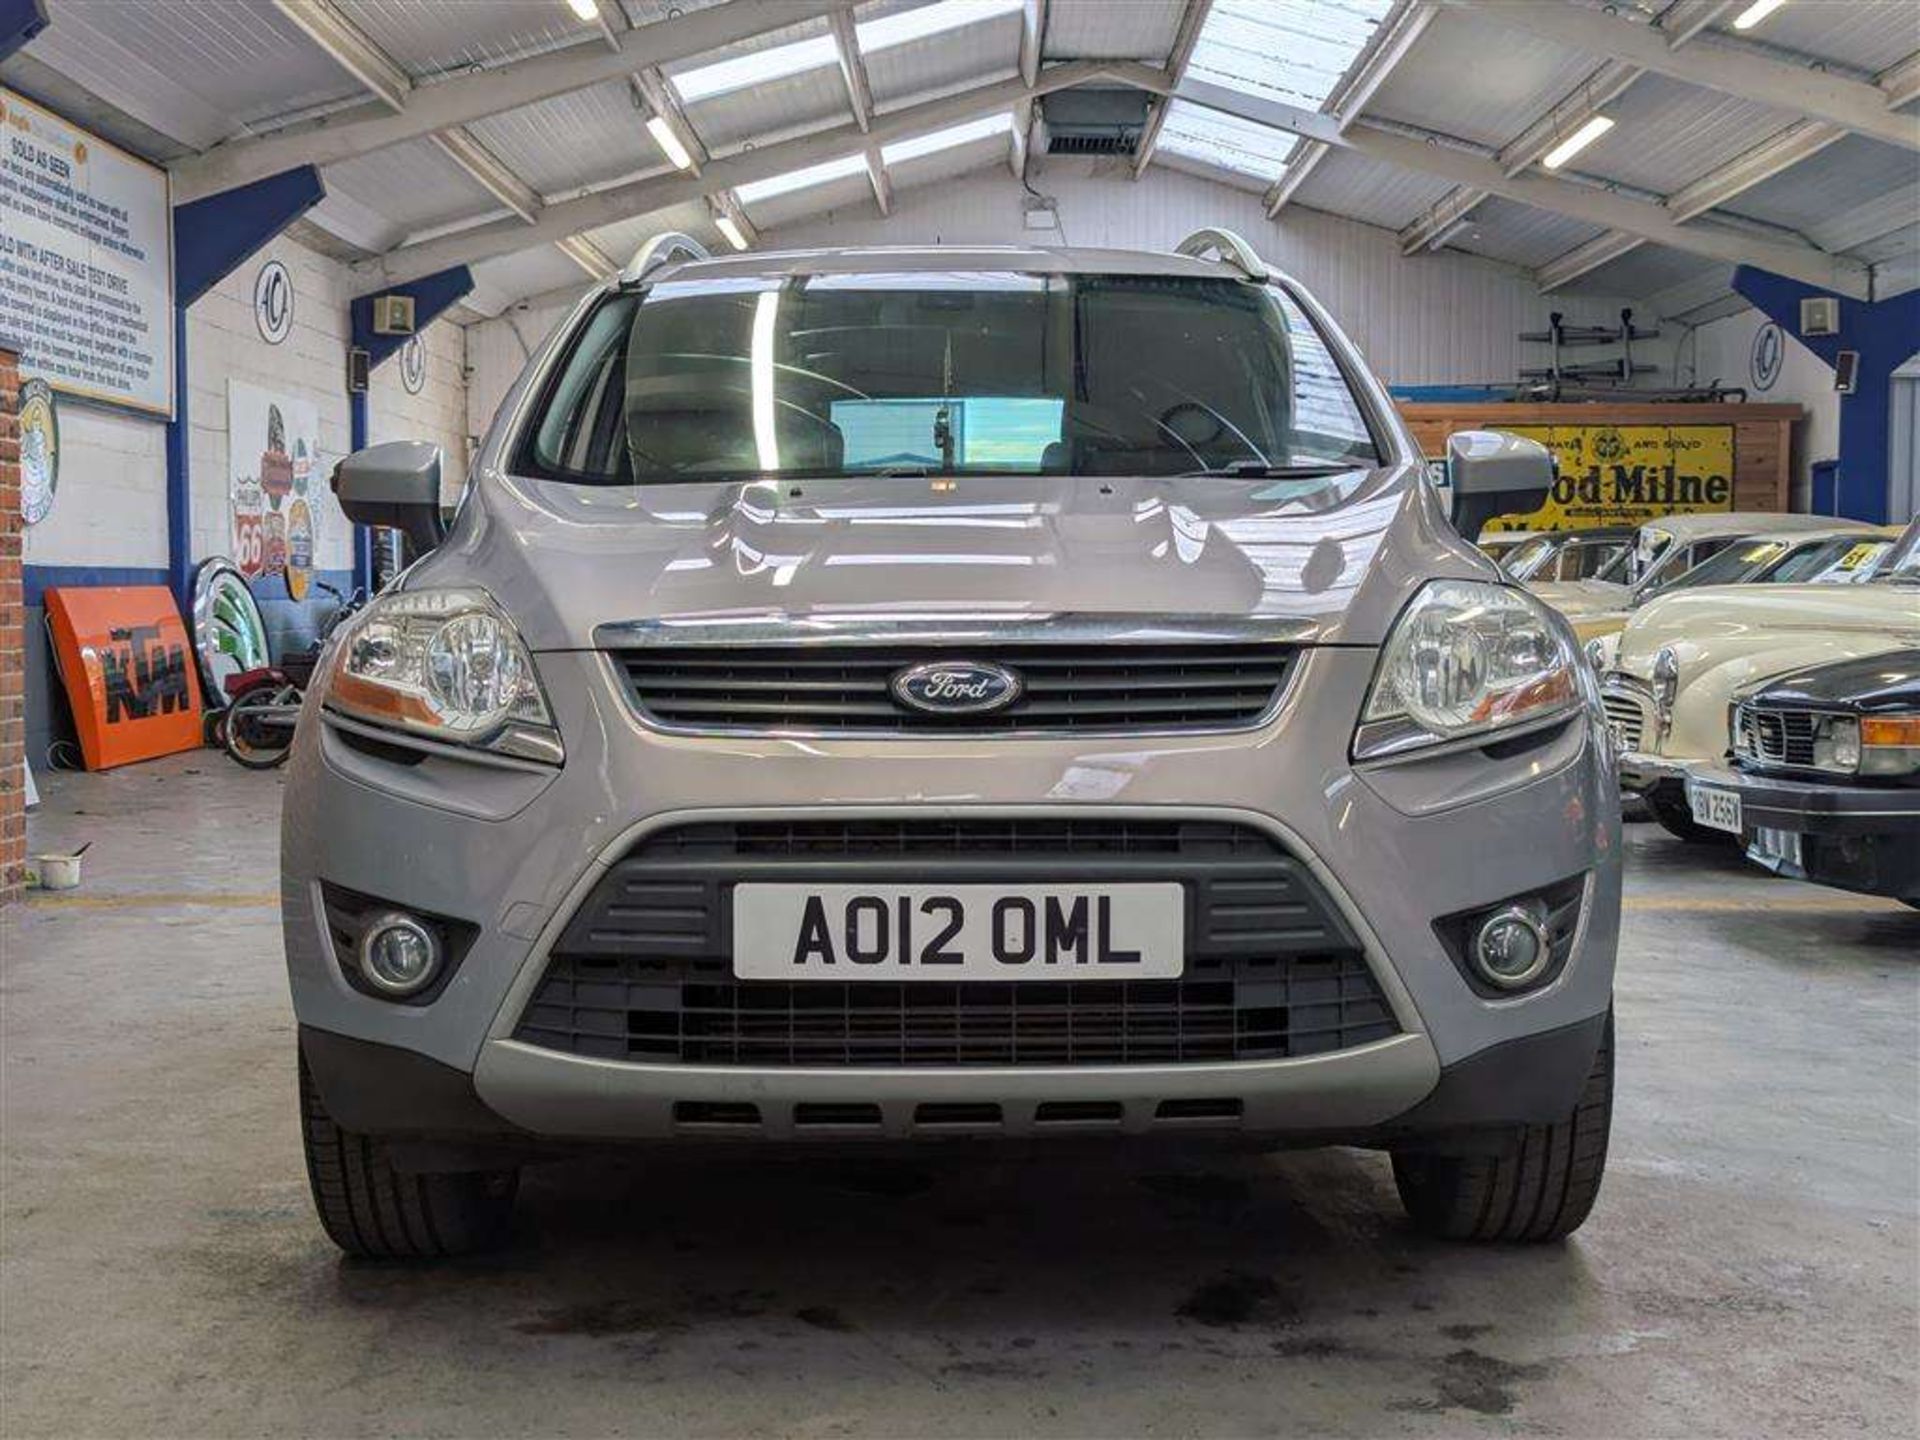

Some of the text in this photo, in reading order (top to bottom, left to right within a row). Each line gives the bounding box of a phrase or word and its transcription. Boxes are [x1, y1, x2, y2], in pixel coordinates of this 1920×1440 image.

[12, 138, 70, 178] SOLD AS SEEN
[0, 233, 128, 296] OLD WITH AFTER SALE TEST DRIVE
[1552, 464, 1729, 504] od Milne
[240, 524, 262, 564] 66
[101, 625, 190, 724] KTM
[924, 672, 990, 698] Ford
[793, 895, 1141, 965] AO12 OML
